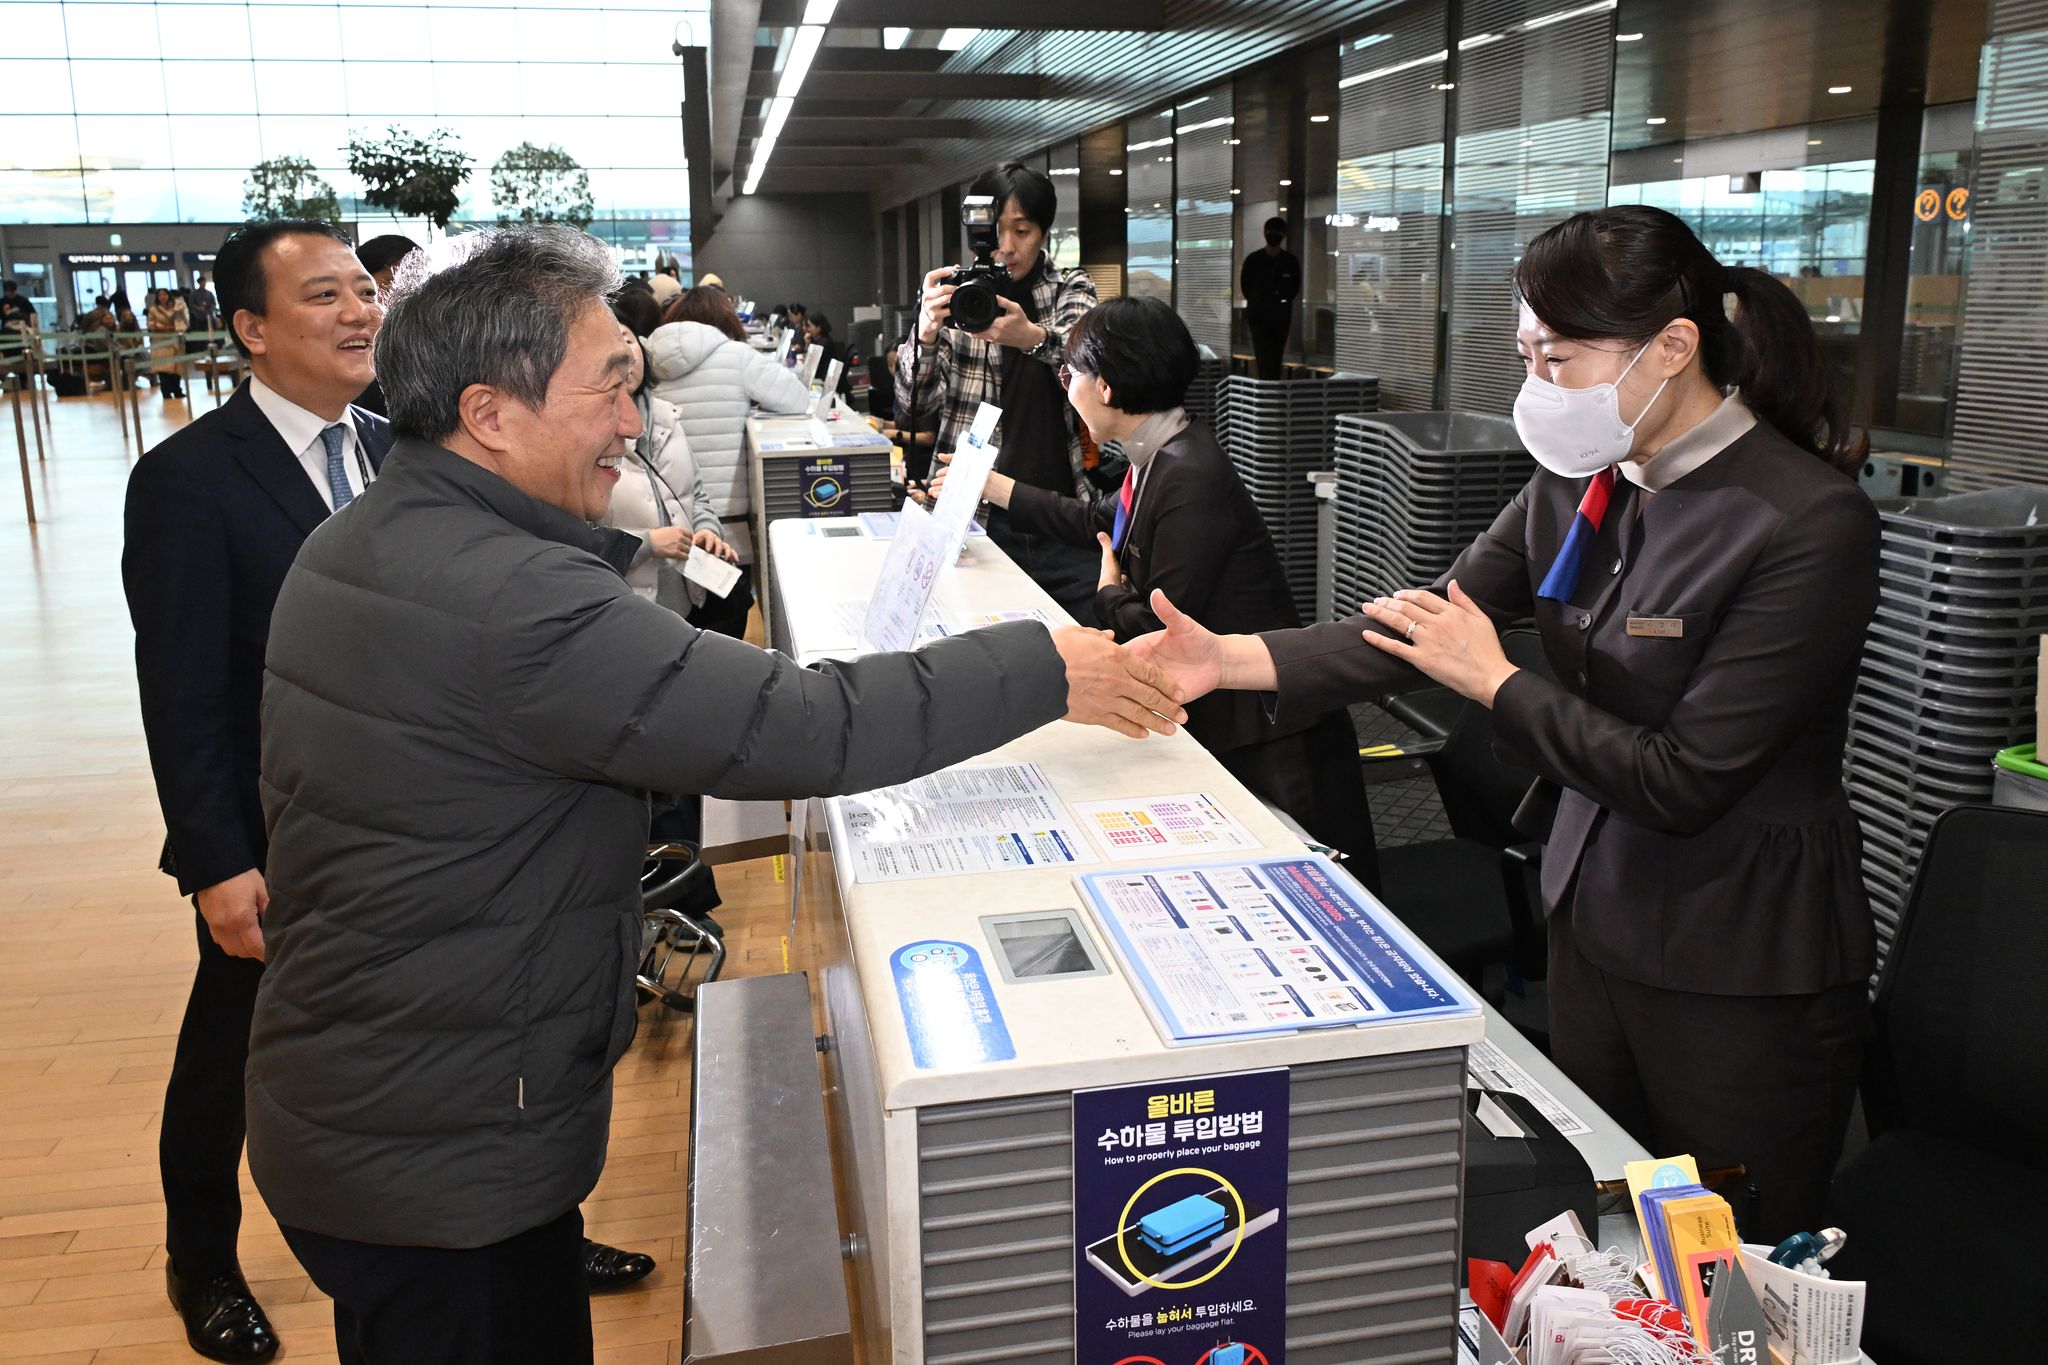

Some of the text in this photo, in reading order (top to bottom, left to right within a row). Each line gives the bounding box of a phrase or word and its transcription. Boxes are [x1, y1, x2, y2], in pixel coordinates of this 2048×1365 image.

[1319, 900, 1346, 922] GOODS
[1147, 1089, 1215, 1119] 올바른
[1097, 1110, 1263, 1152] 수하물 투입방법
[1104, 1139, 1261, 1166] How to properly place your baggage
[1105, 1299, 1258, 1331] 수하물을 눕혀서 투입하세요.
[1128, 1317, 1235, 1339] Please lay your baggage flat.
[1737, 1330, 1758, 1365] DR
